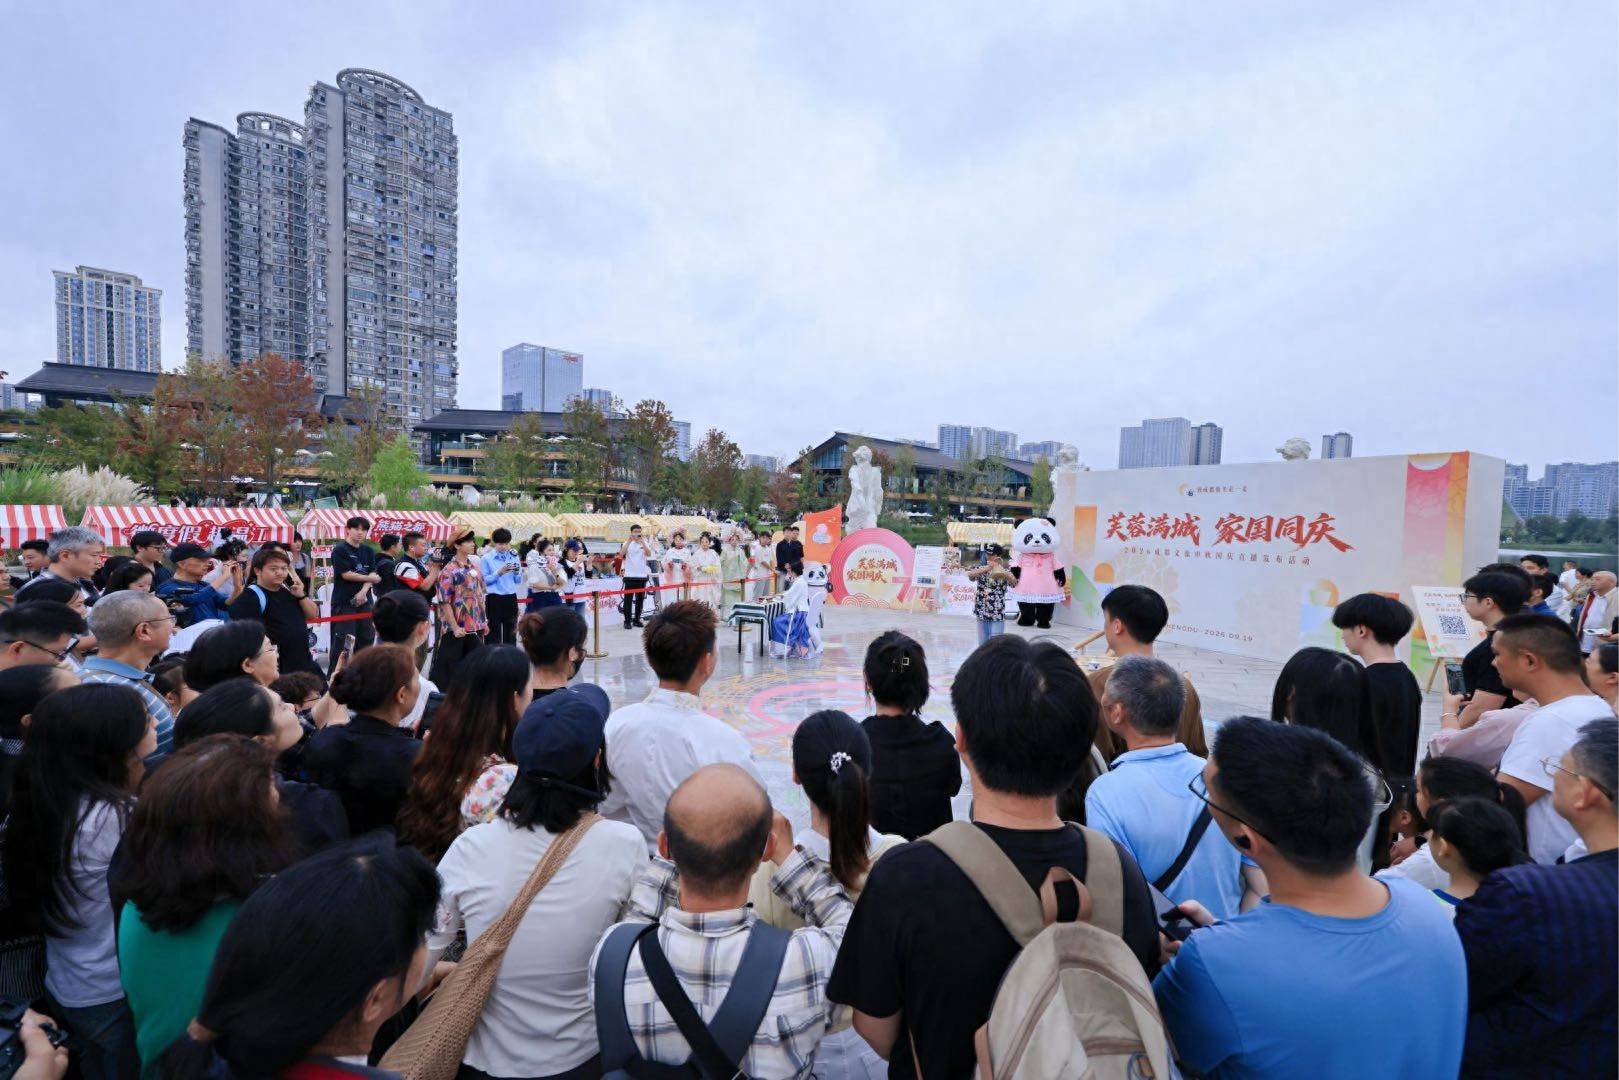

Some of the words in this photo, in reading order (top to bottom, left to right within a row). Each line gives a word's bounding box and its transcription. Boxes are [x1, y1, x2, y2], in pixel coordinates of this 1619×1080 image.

[1104, 511, 1200, 546] 芙蓉满城
[1212, 511, 1354, 553] 家国同庆
[858, 557, 898, 573] 芙蓉满城
[847, 569, 887, 584] 家国同庆
